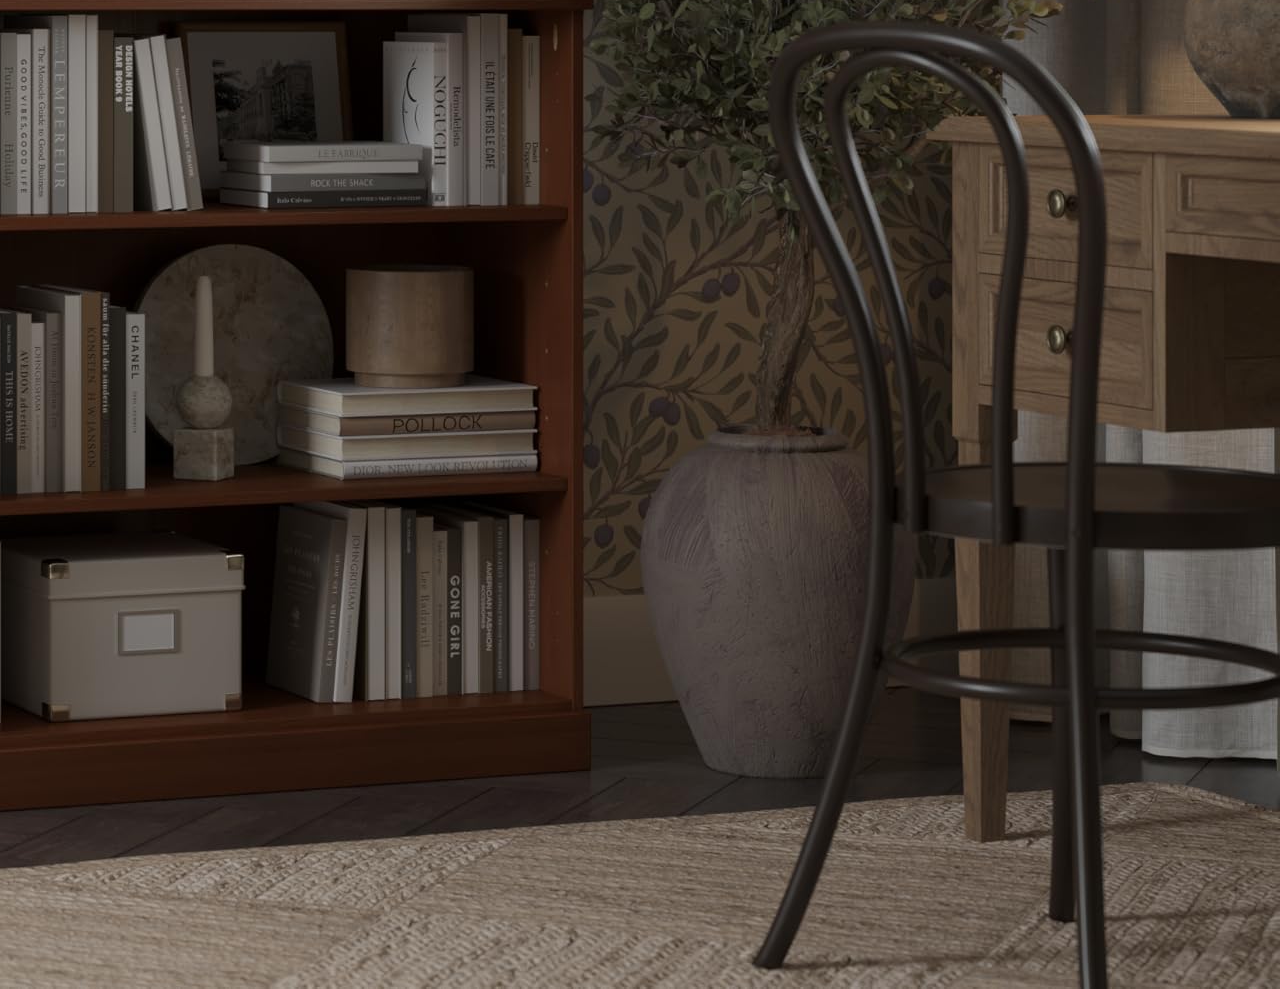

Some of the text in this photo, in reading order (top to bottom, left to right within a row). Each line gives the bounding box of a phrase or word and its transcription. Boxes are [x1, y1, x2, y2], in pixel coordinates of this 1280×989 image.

[38, 46, 46, 63] The
[486, 61, 496, 70] IL
[115, 45, 123, 95] YEAR BOOK
[125, 45, 133, 113] DESIGN HOTELS
[38, 102, 46, 126] Guide
[452, 86, 462, 147] Remodelista
[486, 96, 496, 112] UNE
[19, 59, 28, 194] GOOD GOOD LIFE
[54, 59, 66, 189] LEMPEREUR
[433, 74, 447, 166] NOGUCHI
[486, 115, 496, 134] FOIS
[38, 139, 46, 161] Good
[486, 136, 496, 146] LE
[310, 178, 375, 188] ROCK THE SHACK
[86, 327, 97, 384] KONSTEN
[102, 360, 110, 372] die
[131, 325, 140, 379] CHANEL
[4, 370, 14, 394] THIS
[4, 397, 14, 408] IS
[19, 350, 29, 451] AVEDON advertising
[4, 410, 14, 443] HOME
[393, 413, 483, 434] POLLOCK
[389, 463, 414, 475] NEW
[454, 458, 528, 472] REVOLUTION
[420, 571, 431, 648] Lee Radziwill
[450, 575, 460, 659] GONE GIRL
[527, 561, 537, 652] STEPHEN MARINO
